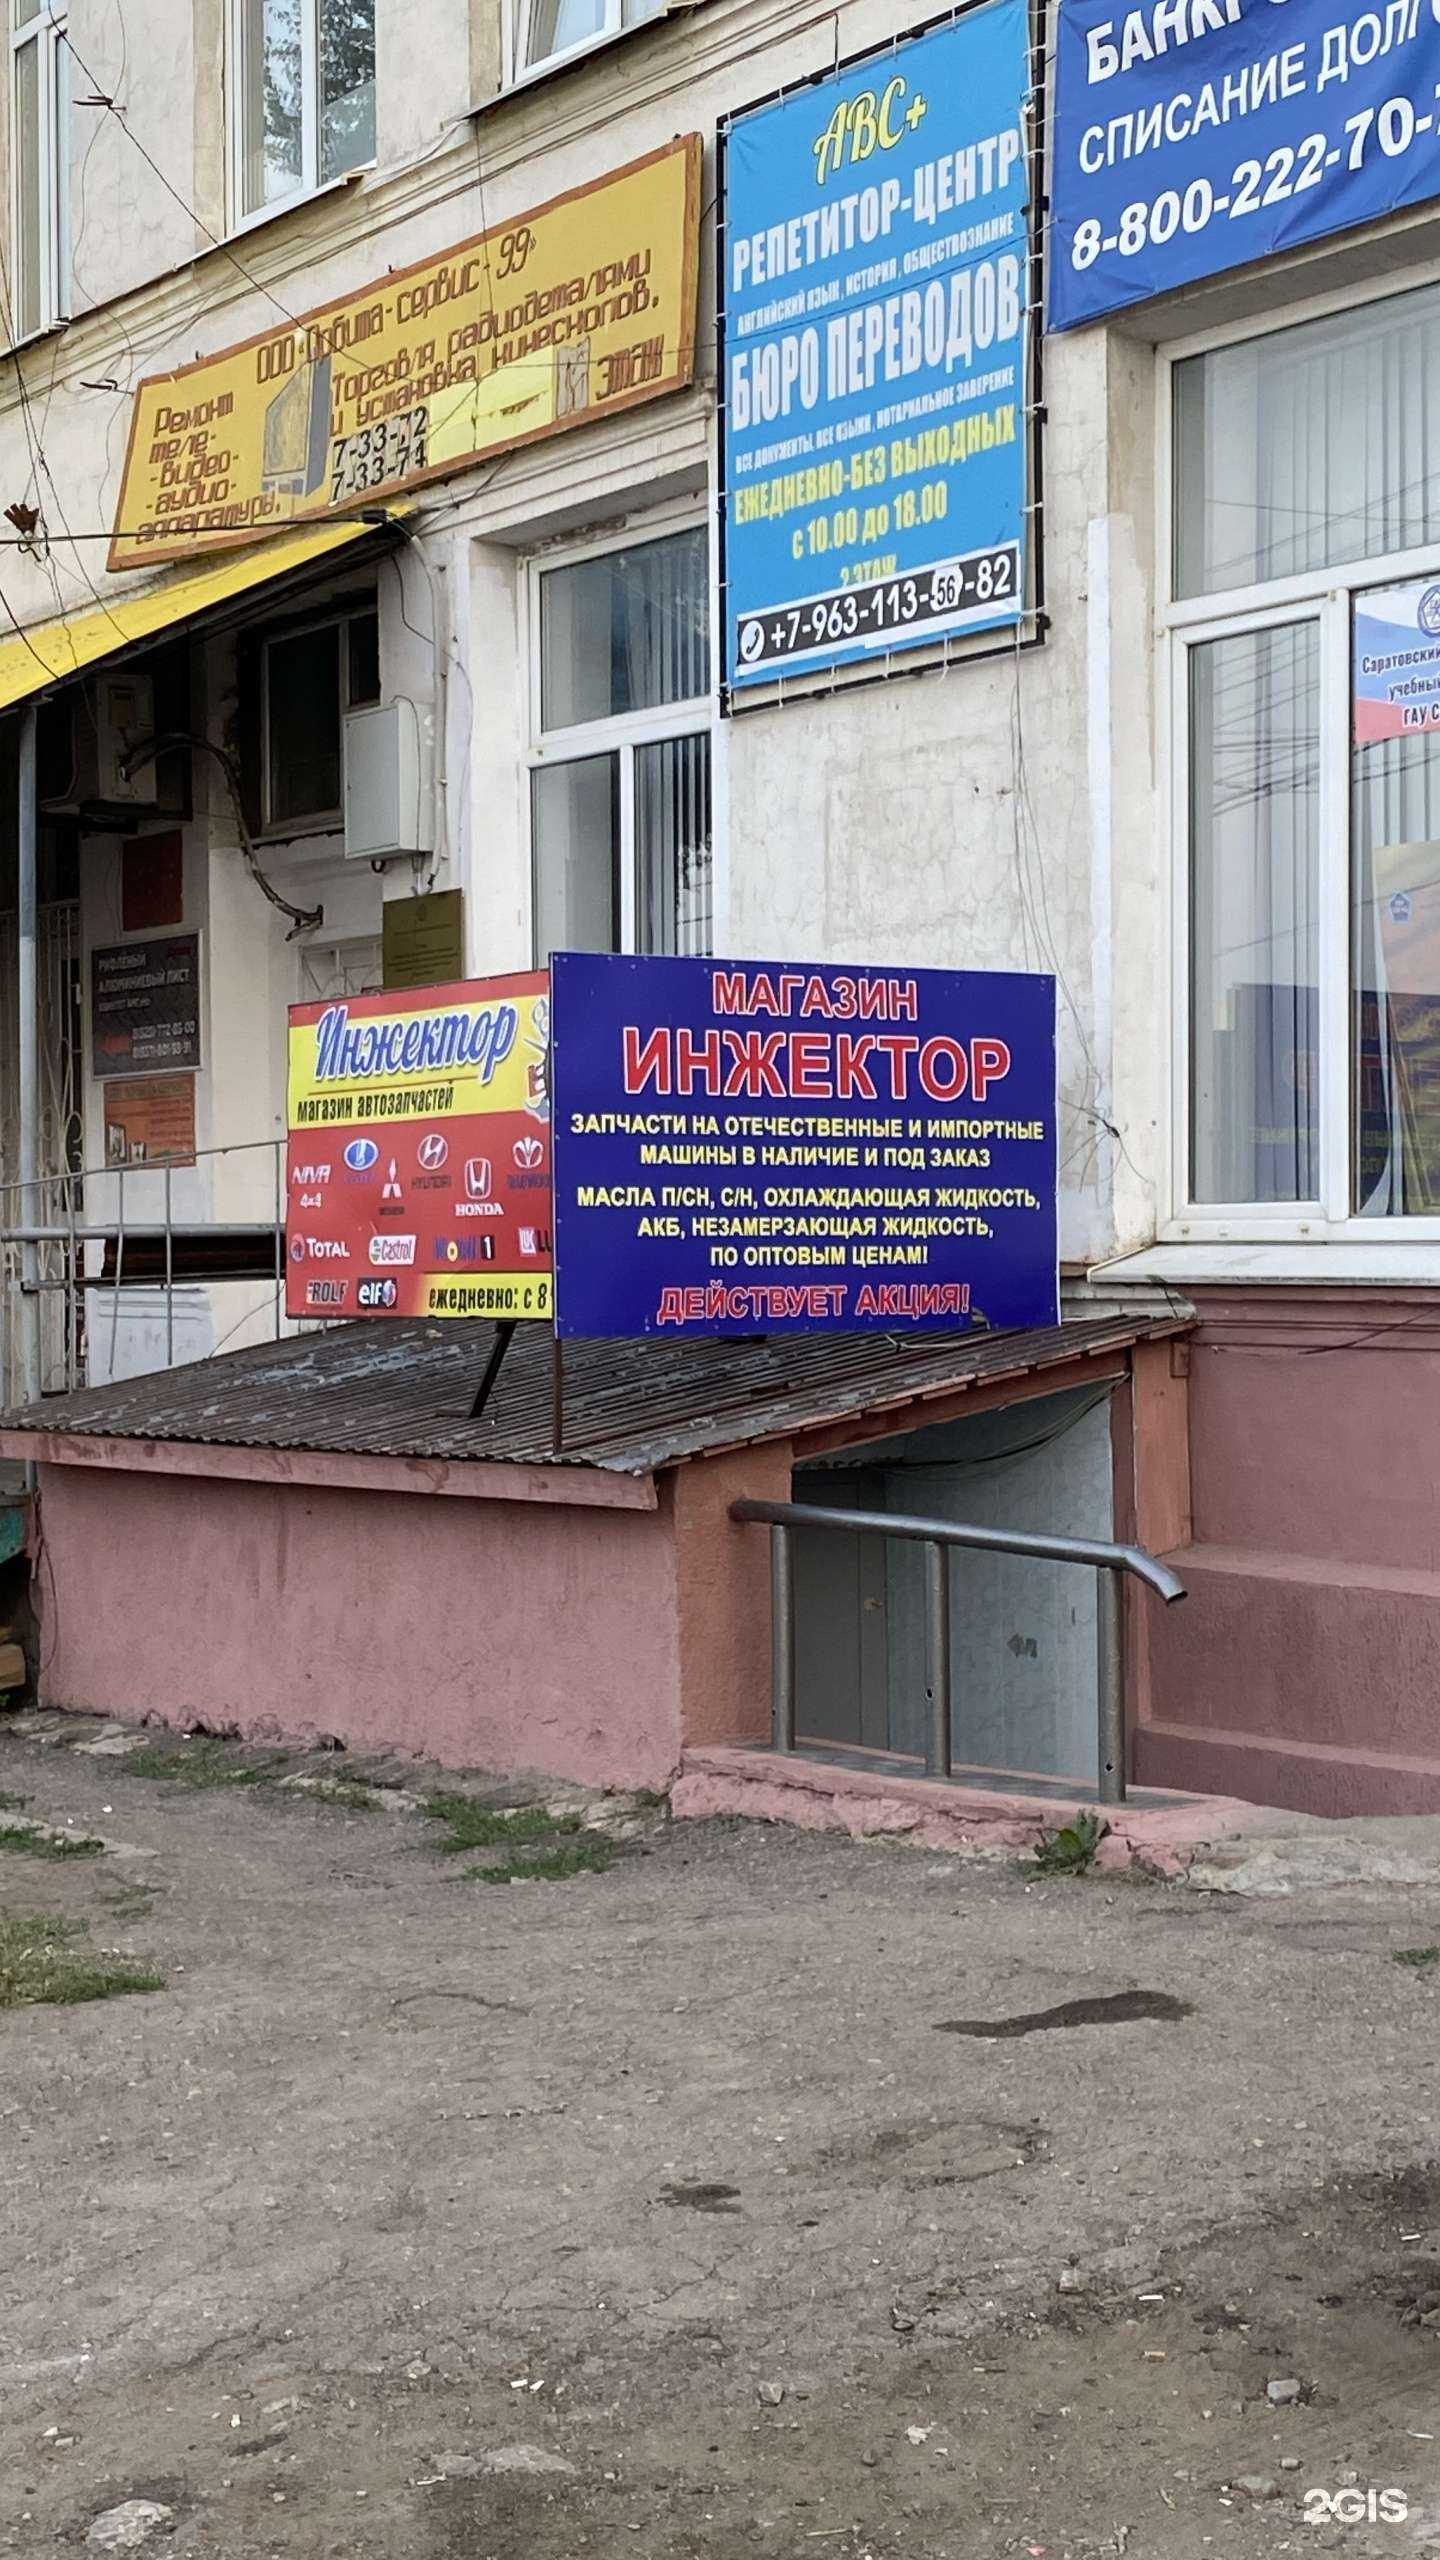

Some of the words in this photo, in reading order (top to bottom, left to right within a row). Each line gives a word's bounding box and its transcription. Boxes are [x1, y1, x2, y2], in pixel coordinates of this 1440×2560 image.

[1087, 0, 1289, 85] БАНК
[1079, 42, 1306, 175] СПИСАНИЕ
[1316, 0, 1440, 93] ДОЛГ
[1072, 84, 1440, 271] 8-800-222-70-
[732, 128, 1019, 293] РЕПЕТИТОР-ЦЕНТР
[737, 289, 806, 336] АНГЛИЙСКИЙ
[903, 211, 1014, 276] ОБЩЕСТВОЗНАНИЕ
[332, 339, 435, 406] Торговля
[449, 249, 652, 366] радиодеталями
[732, 327, 819, 432] БЮРО
[827, 254, 1019, 400] ПЕРЕВОДОВ
[257, 334, 295, 384] ООО
[153, 391, 234, 438] Ремонт
[330, 409, 343, 436] и
[356, 352, 477, 427] установка
[736, 452, 753, 474] ВСЕ
[816, 425, 834, 449] ВСЕ
[877, 385, 954, 430] НОТАРИАЛЬНОЕ
[957, 365, 1014, 402] ЗАВЕРЕНИЕ
[149, 430, 216, 464] теле-
[734, 445, 886, 525] ЕЖЕДНЕВНО-БЕЗ
[891, 403, 1015, 478] ВЫХОДНЫХ
[808, 508, 857, 555] 10.00
[893, 481, 947, 530] 18.00
[1404, 705, 1427, 726] ГАУ
[712, 971, 917, 1021] МАГАЗИН
[314, 1003, 518, 1087] Инжектор
[623, 1026, 1011, 1102] ИНЖЕКТОР
[297, 1093, 352, 1122] магазин
[357, 1085, 454, 1119] автозапчастей
[570, 1113, 686, 1135] ЗАПЧАСТИ
[692, 1115, 720, 1136] НА
[724, 1116, 903, 1138] ОТЕЧЕСТВЕННЫЕ
[908, 1119, 922, 1139] И
[927, 1119, 1044, 1141] ИМПОРТНЫЕ
[640, 1144, 737, 1165] МАШИНЫ
[742, 1146, 756, 1166] В
[761, 1146, 859, 1167] НАЛИЧИЕ
[864, 1148, 878, 1167] И
[883, 1148, 926, 1170] ПОД
[930, 1148, 991, 1168] ЗАКАЗ
[455, 1203, 504, 1216] HONDA
[577, 1186, 656, 1207] МАСЛА
[661, 1187, 715, 1210] П/СН,
[720, 1187, 758, 1210] С/Н,
[763, 1187, 930, 1210] ОХЛАЖДАЮЩАЯ
[935, 1187, 1041, 1210] ЖИДКОСТЬ,
[382, 1240, 413, 1261] Castrol
[637, 1216, 686, 1239] АКБ,
[692, 1216, 876, 1239] НЕЗАМЕРЗАЮЩАЯ
[882, 1216, 993, 1239] ЖИДКОСТЬ,
[710, 1246, 738, 1266] ПО
[743, 1246, 846, 1266] ОПТОВЫМ
[852, 1245, 928, 1268] ЦЕНАМ!
[359, 1283, 383, 1304] elf
[429, 1287, 518, 1312] ежедневно:
[524, 1288, 532, 1309] с
[656, 1279, 847, 1326] ДЕЙСТВУЕТ
[854, 1283, 970, 1320] АКЦИЯ!
